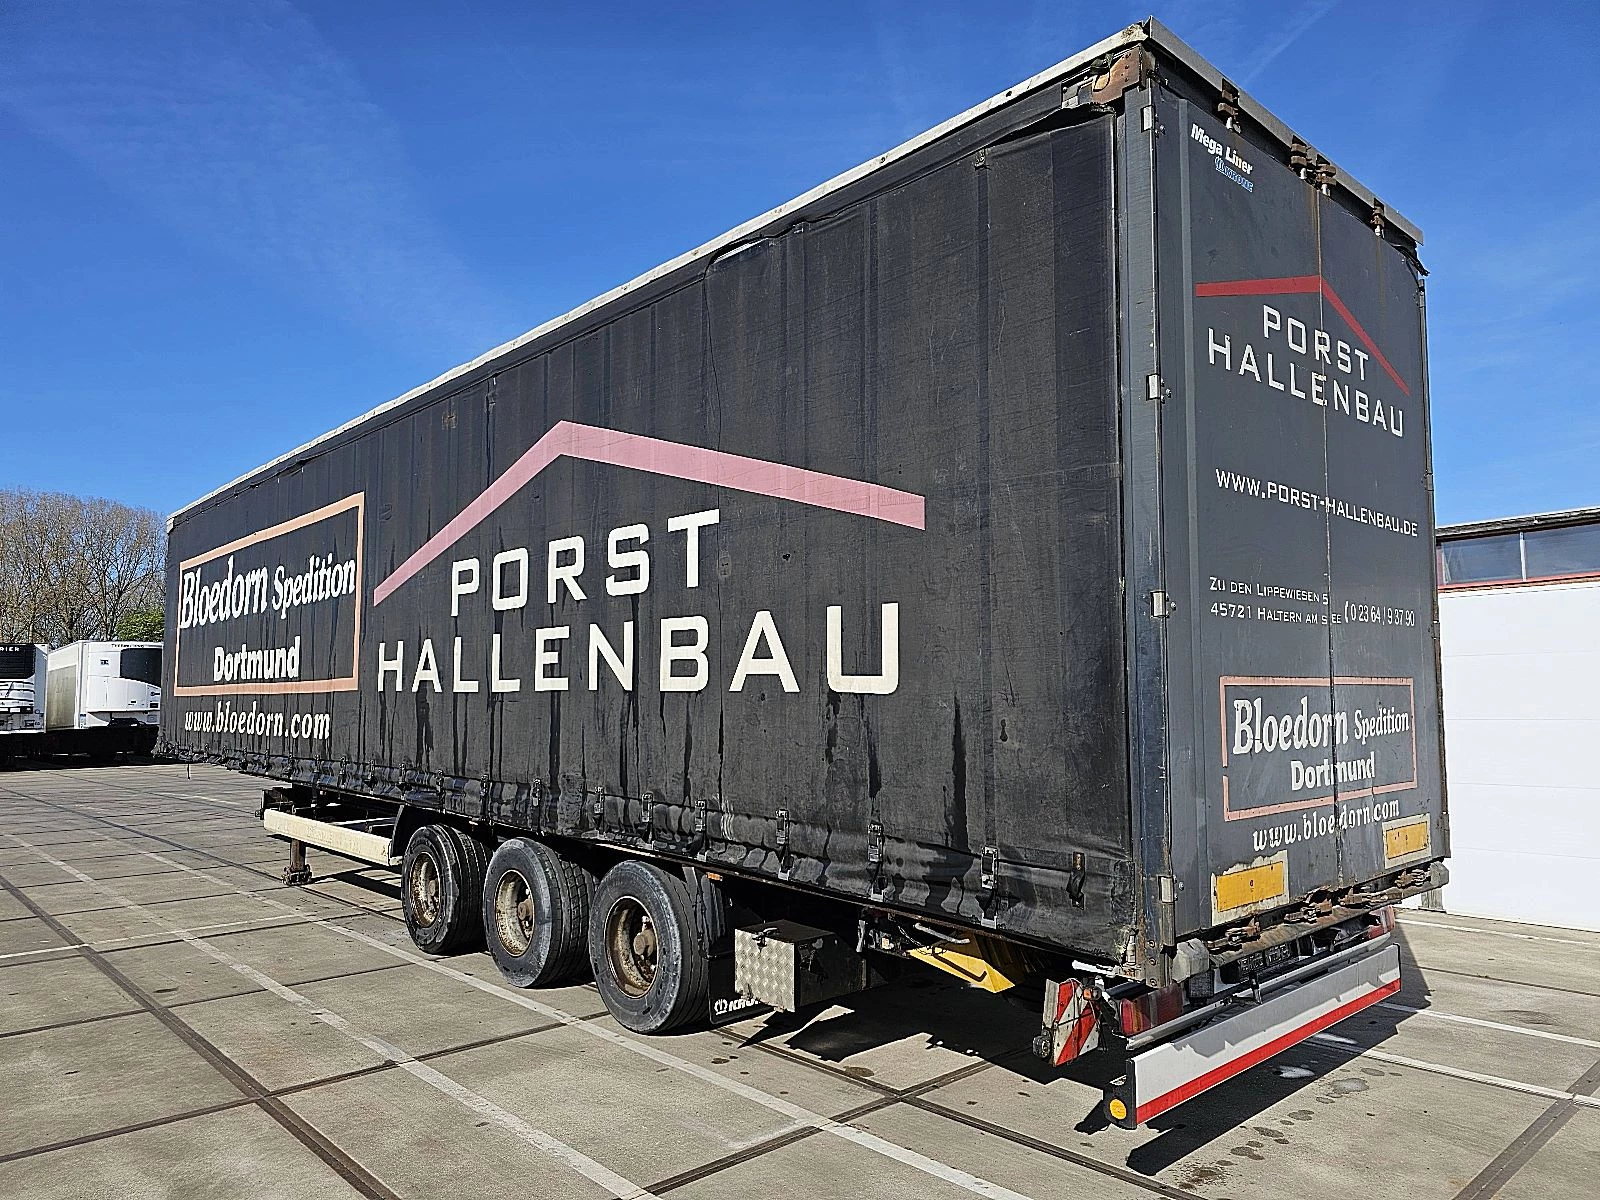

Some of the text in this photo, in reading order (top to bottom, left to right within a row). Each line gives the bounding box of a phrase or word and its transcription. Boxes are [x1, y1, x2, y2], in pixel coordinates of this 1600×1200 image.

[1191, 123, 1253, 175] Mega Liner
[1263, 304, 1369, 381] PORST
[1208, 327, 1403, 437] HALLENBAU
[451, 509, 720, 616] PORST
[1230, 581, 1252, 595] DEN
[180, 552, 356, 630] Bloedorn Spedition
[1210, 602, 1252, 619] 45721
[1257, 607, 1302, 623] HALTERN
[213, 636, 300, 682] Dortmund
[376, 602, 900, 695] HALLENBAU
[184, 701, 331, 740] www.bloedorn.com
[1232, 696, 1410, 754] Bloedorn Spedition
[1290, 751, 1376, 791] Dortmund
[1252, 799, 1400, 852] www.bloedorn.com
